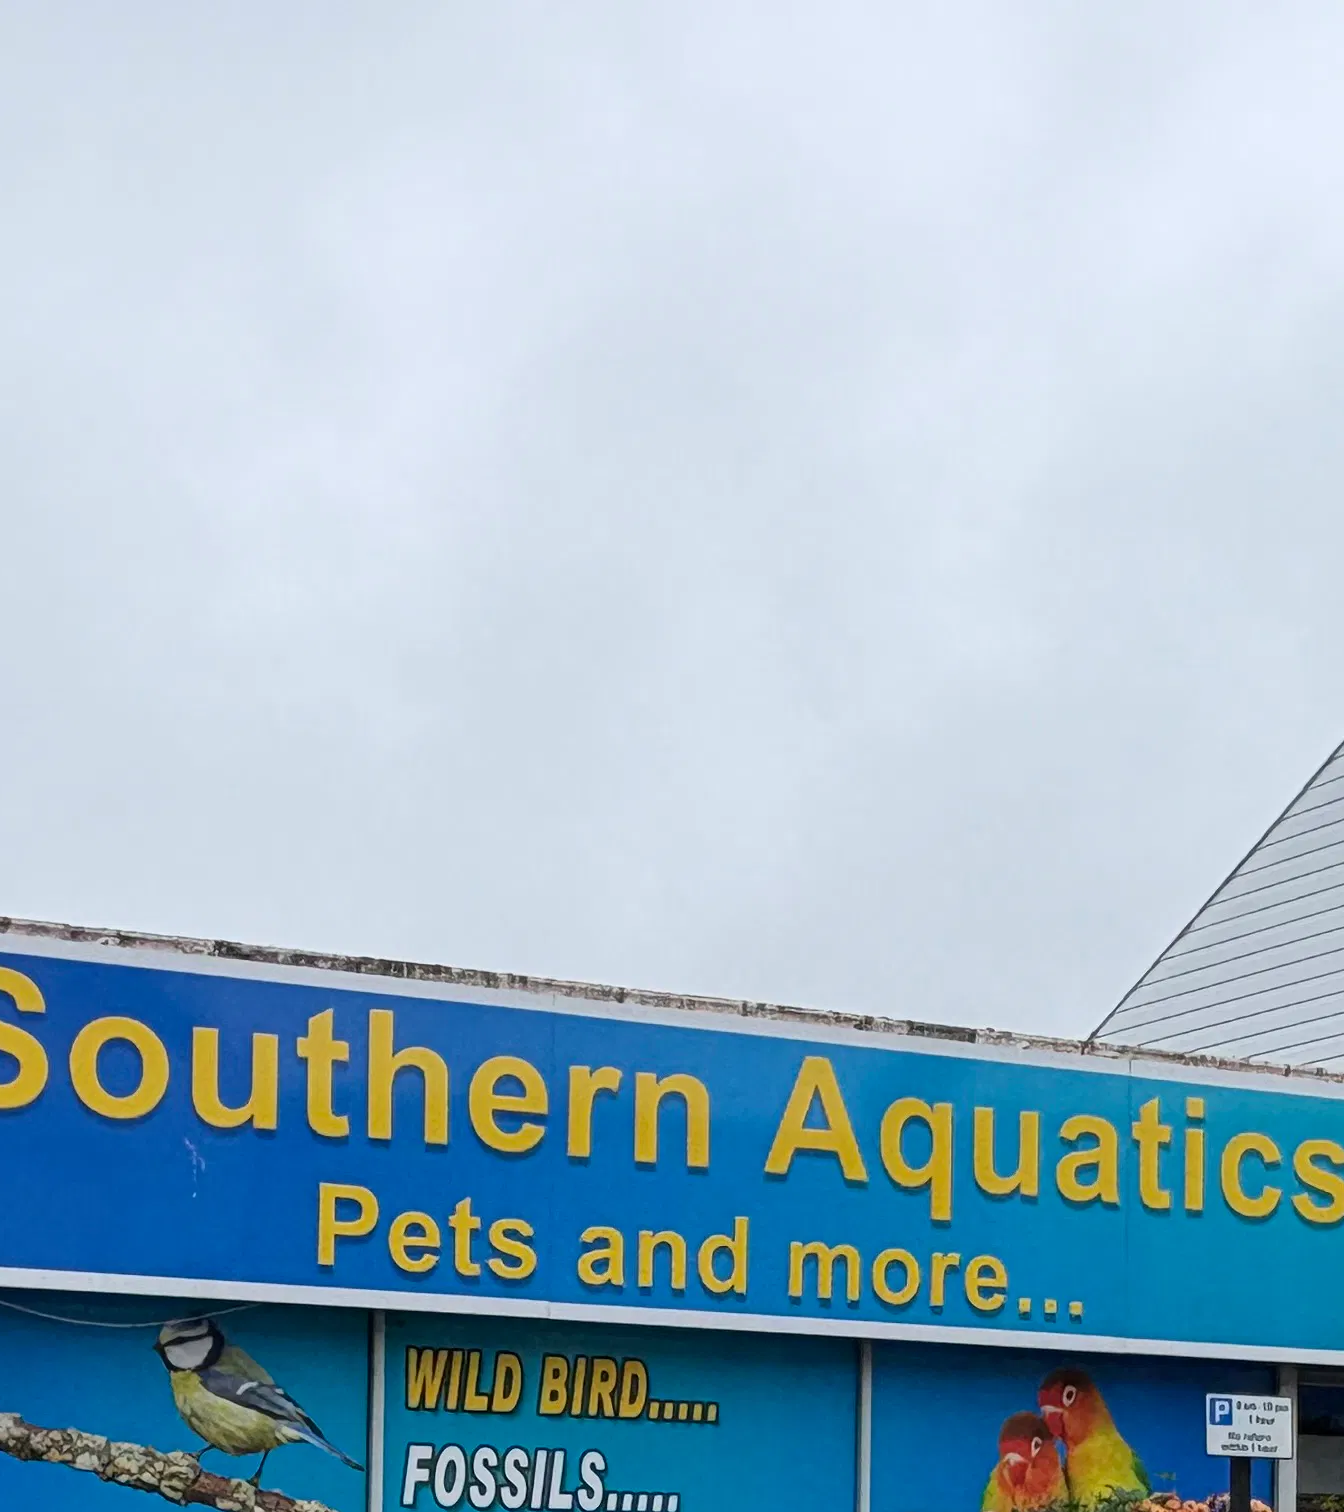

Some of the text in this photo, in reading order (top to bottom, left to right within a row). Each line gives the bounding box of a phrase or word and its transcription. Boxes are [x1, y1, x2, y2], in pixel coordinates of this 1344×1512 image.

[317, 1182, 1083, 1316] Pets and more...
[406, 1346, 718, 1423] WILD BIRD.....
